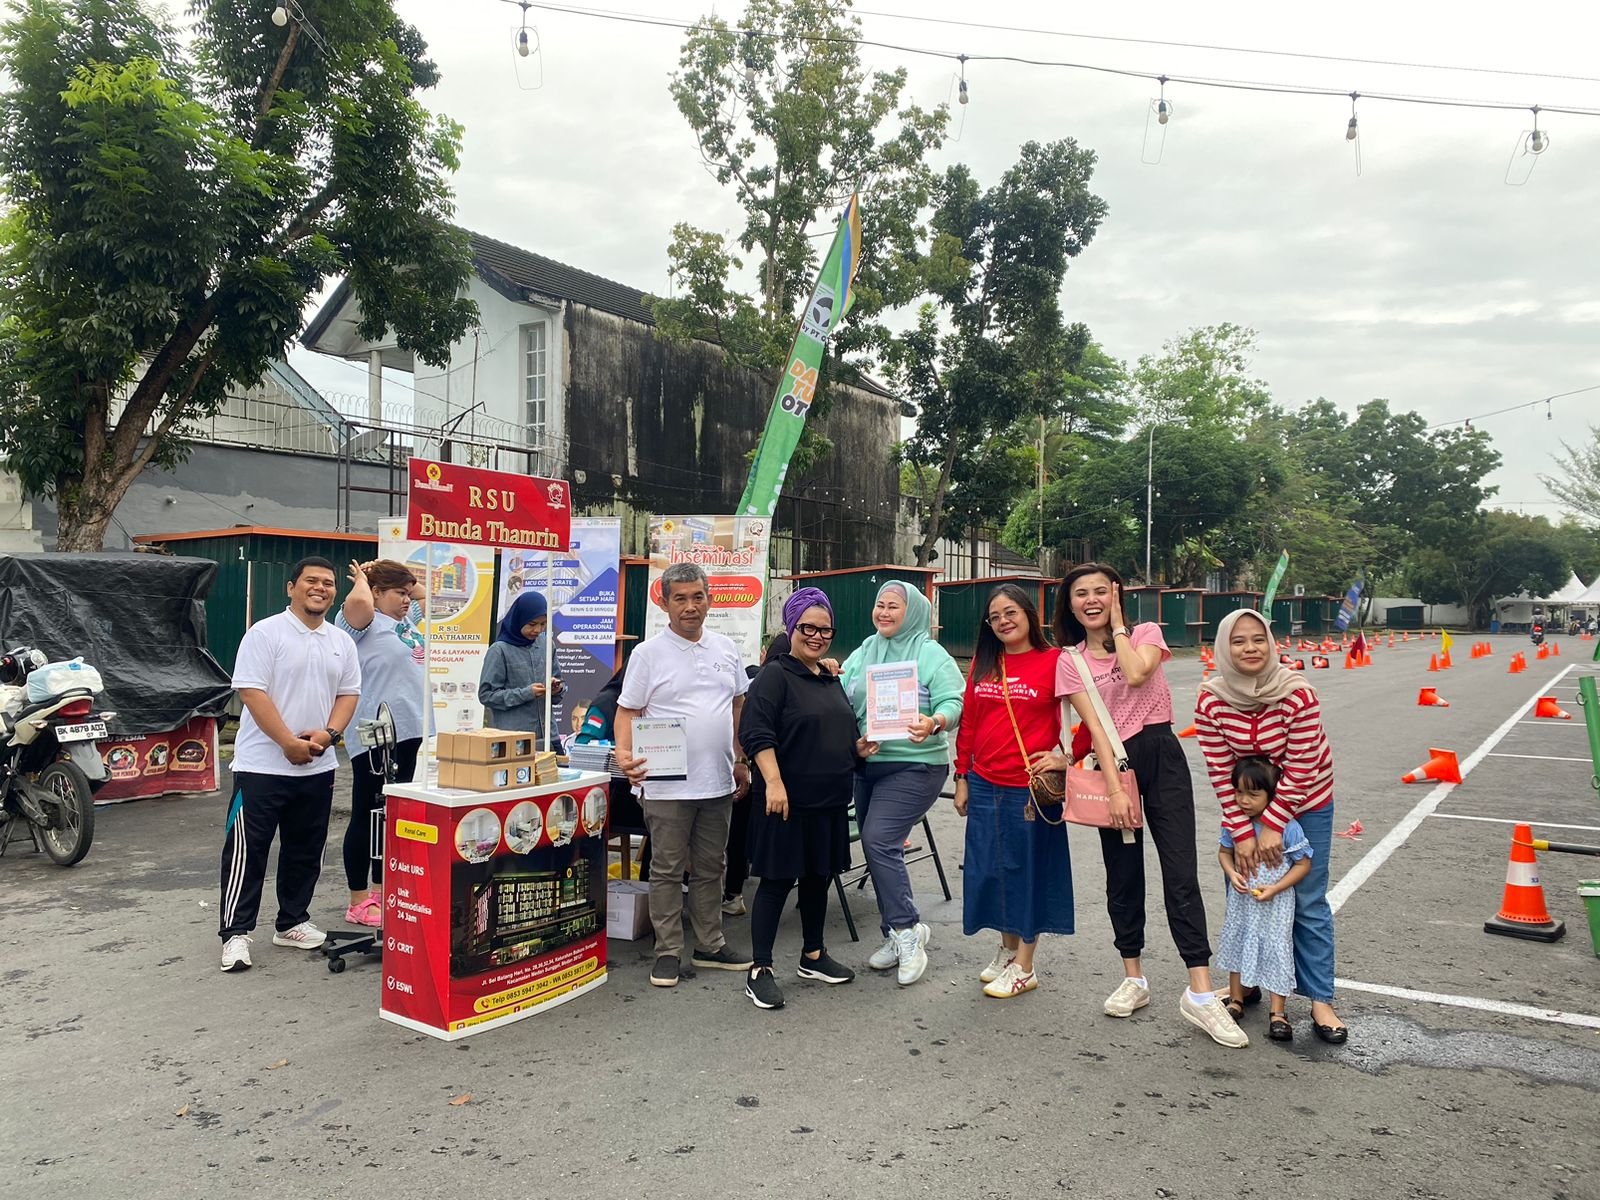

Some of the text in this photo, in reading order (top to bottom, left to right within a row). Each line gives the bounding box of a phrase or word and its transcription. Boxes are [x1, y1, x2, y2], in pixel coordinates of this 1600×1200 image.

[801, 323, 810, 333] by
[810, 328, 821, 339] PT
[790, 360, 818, 387] DA
[793, 380, 815, 402] TU
[780, 395, 808, 416] OT
[419, 512, 560, 549] Bunda Thamrin
[238, 546, 245, 560] 1
[669, 540, 755, 566] Inseminasi
[870, 575, 877, 584] 4
[57, 727, 68, 735] BK
[415, 829, 427, 838] Care
[397, 861, 425, 876] Alat URS
[397, 887, 410, 898] Unit
[397, 899, 432, 915] Hemodialisa
[397, 909, 417, 923] 24 Jam
[397, 941, 414, 955] CRRT
[396, 980, 414, 995] ESWL
[491, 995, 505, 1005] Telp
[506, 990, 521, 1001] 0853
[521, 985, 535, 996] 5947
[535, 980, 549, 991] 3042
[552, 976, 562, 986] WA
